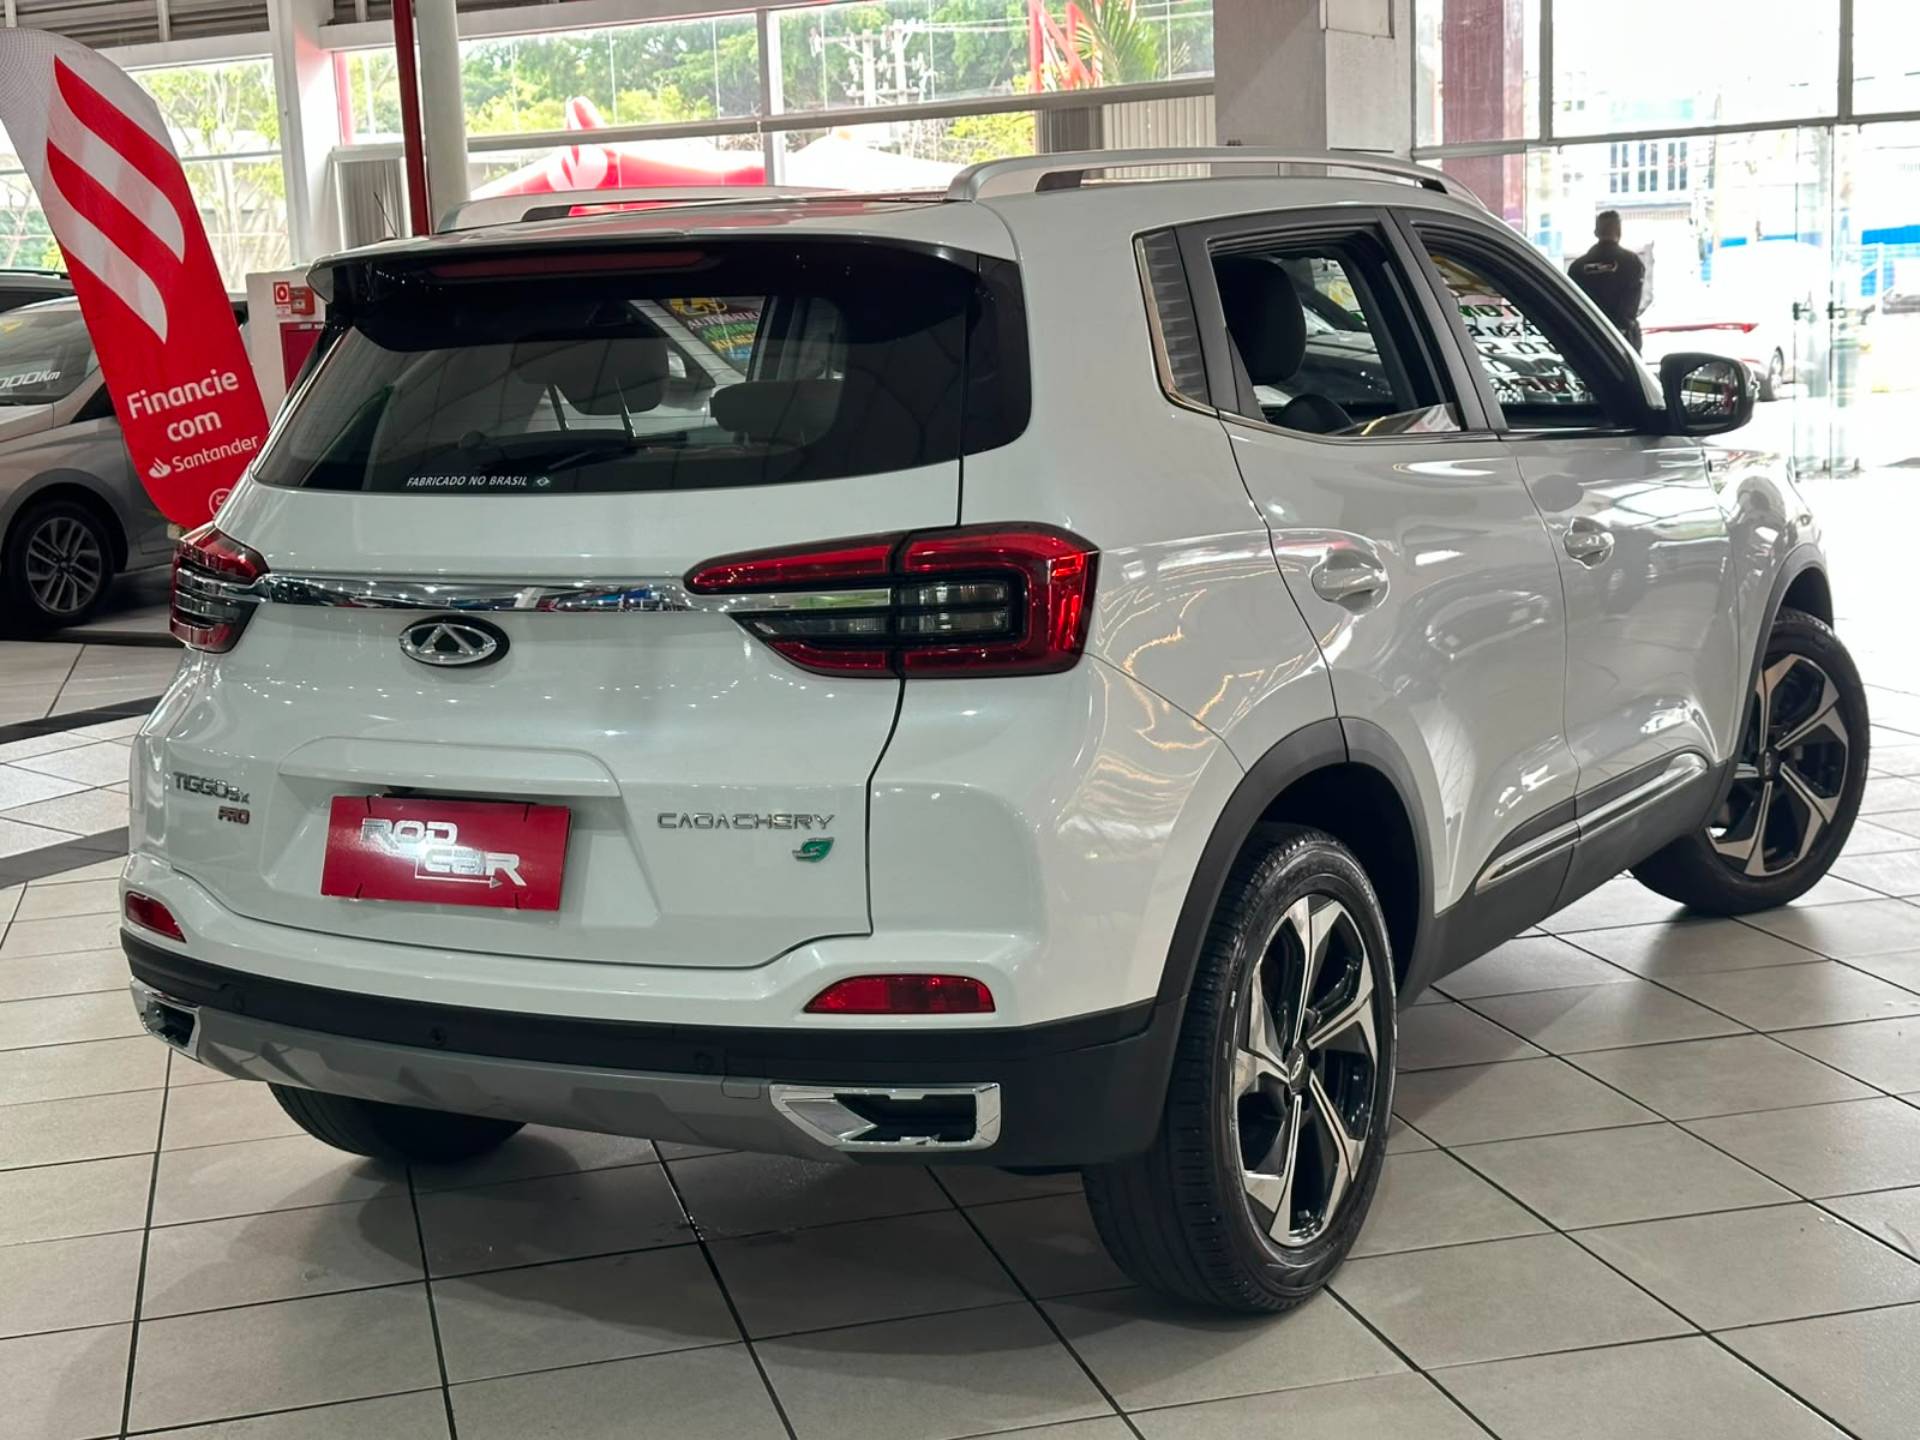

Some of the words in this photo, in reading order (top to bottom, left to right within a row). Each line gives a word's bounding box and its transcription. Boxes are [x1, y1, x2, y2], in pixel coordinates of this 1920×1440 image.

[127, 369, 240, 420] Financie
[167, 411, 222, 442] com
[172, 436, 259, 472] Santander
[406, 476, 466, 487] FABRICADO
[468, 476, 487, 486] NO
[489, 476, 528, 486] BRASIL
[360, 817, 458, 850] ROD
